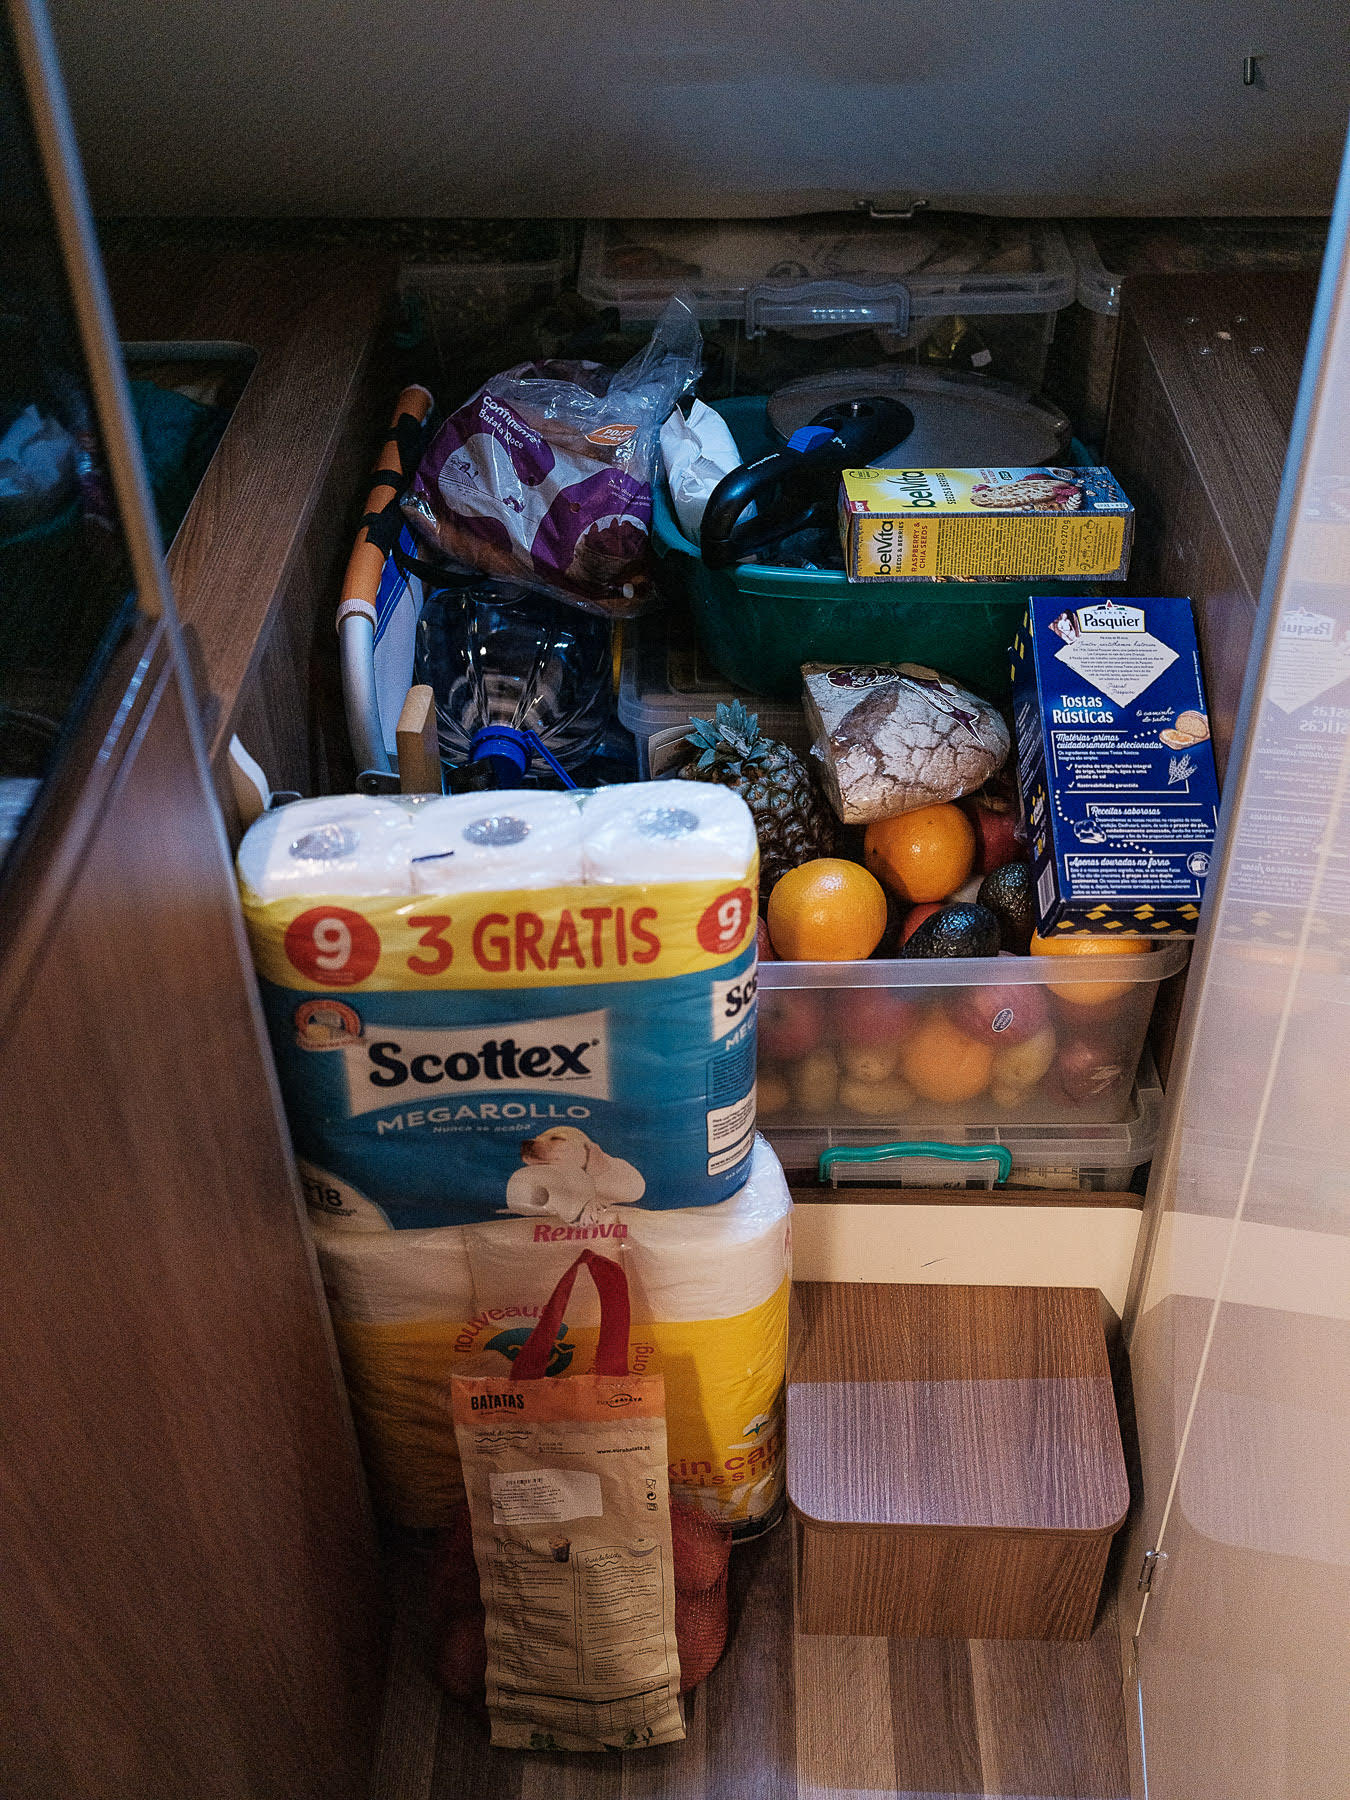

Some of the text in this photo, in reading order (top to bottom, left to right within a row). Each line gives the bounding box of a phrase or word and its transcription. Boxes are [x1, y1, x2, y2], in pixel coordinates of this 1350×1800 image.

[479, 409, 524, 449] Batata Doce
[886, 470, 937, 508] belVita
[945, 491, 956, 504] SEEDS
[873, 520, 894, 575] belVita
[911, 529, 920, 572] RASPBERRY
[919, 525, 928, 569] CHIA SEEDS
[1084, 613, 1140, 629] Pasquier
[1060, 695, 1102, 708] Tostas
[1144, 707, 1175, 716] caminho
[1052, 709, 1114, 724] Rústicas
[1056, 733, 1119, 743] Matérias-primas
[1091, 806, 1160, 817] Receitas saborosas
[1069, 857, 1099, 867] Apenas
[1101, 857, 1136, 866] douradas
[1148, 858, 1170, 868] forno
[717, 898, 742, 941] 9
[312, 918, 353, 970] 9
[406, 906, 662, 975] 3 GRATIS
[368, 1038, 593, 1088] Scottex
[376, 1102, 591, 1136] MEGAROLLO
[432, 1125, 472, 1133] Nunca
[533, 1223, 628, 1243] Renova
[471, 1393, 525, 1411] BATATAS
